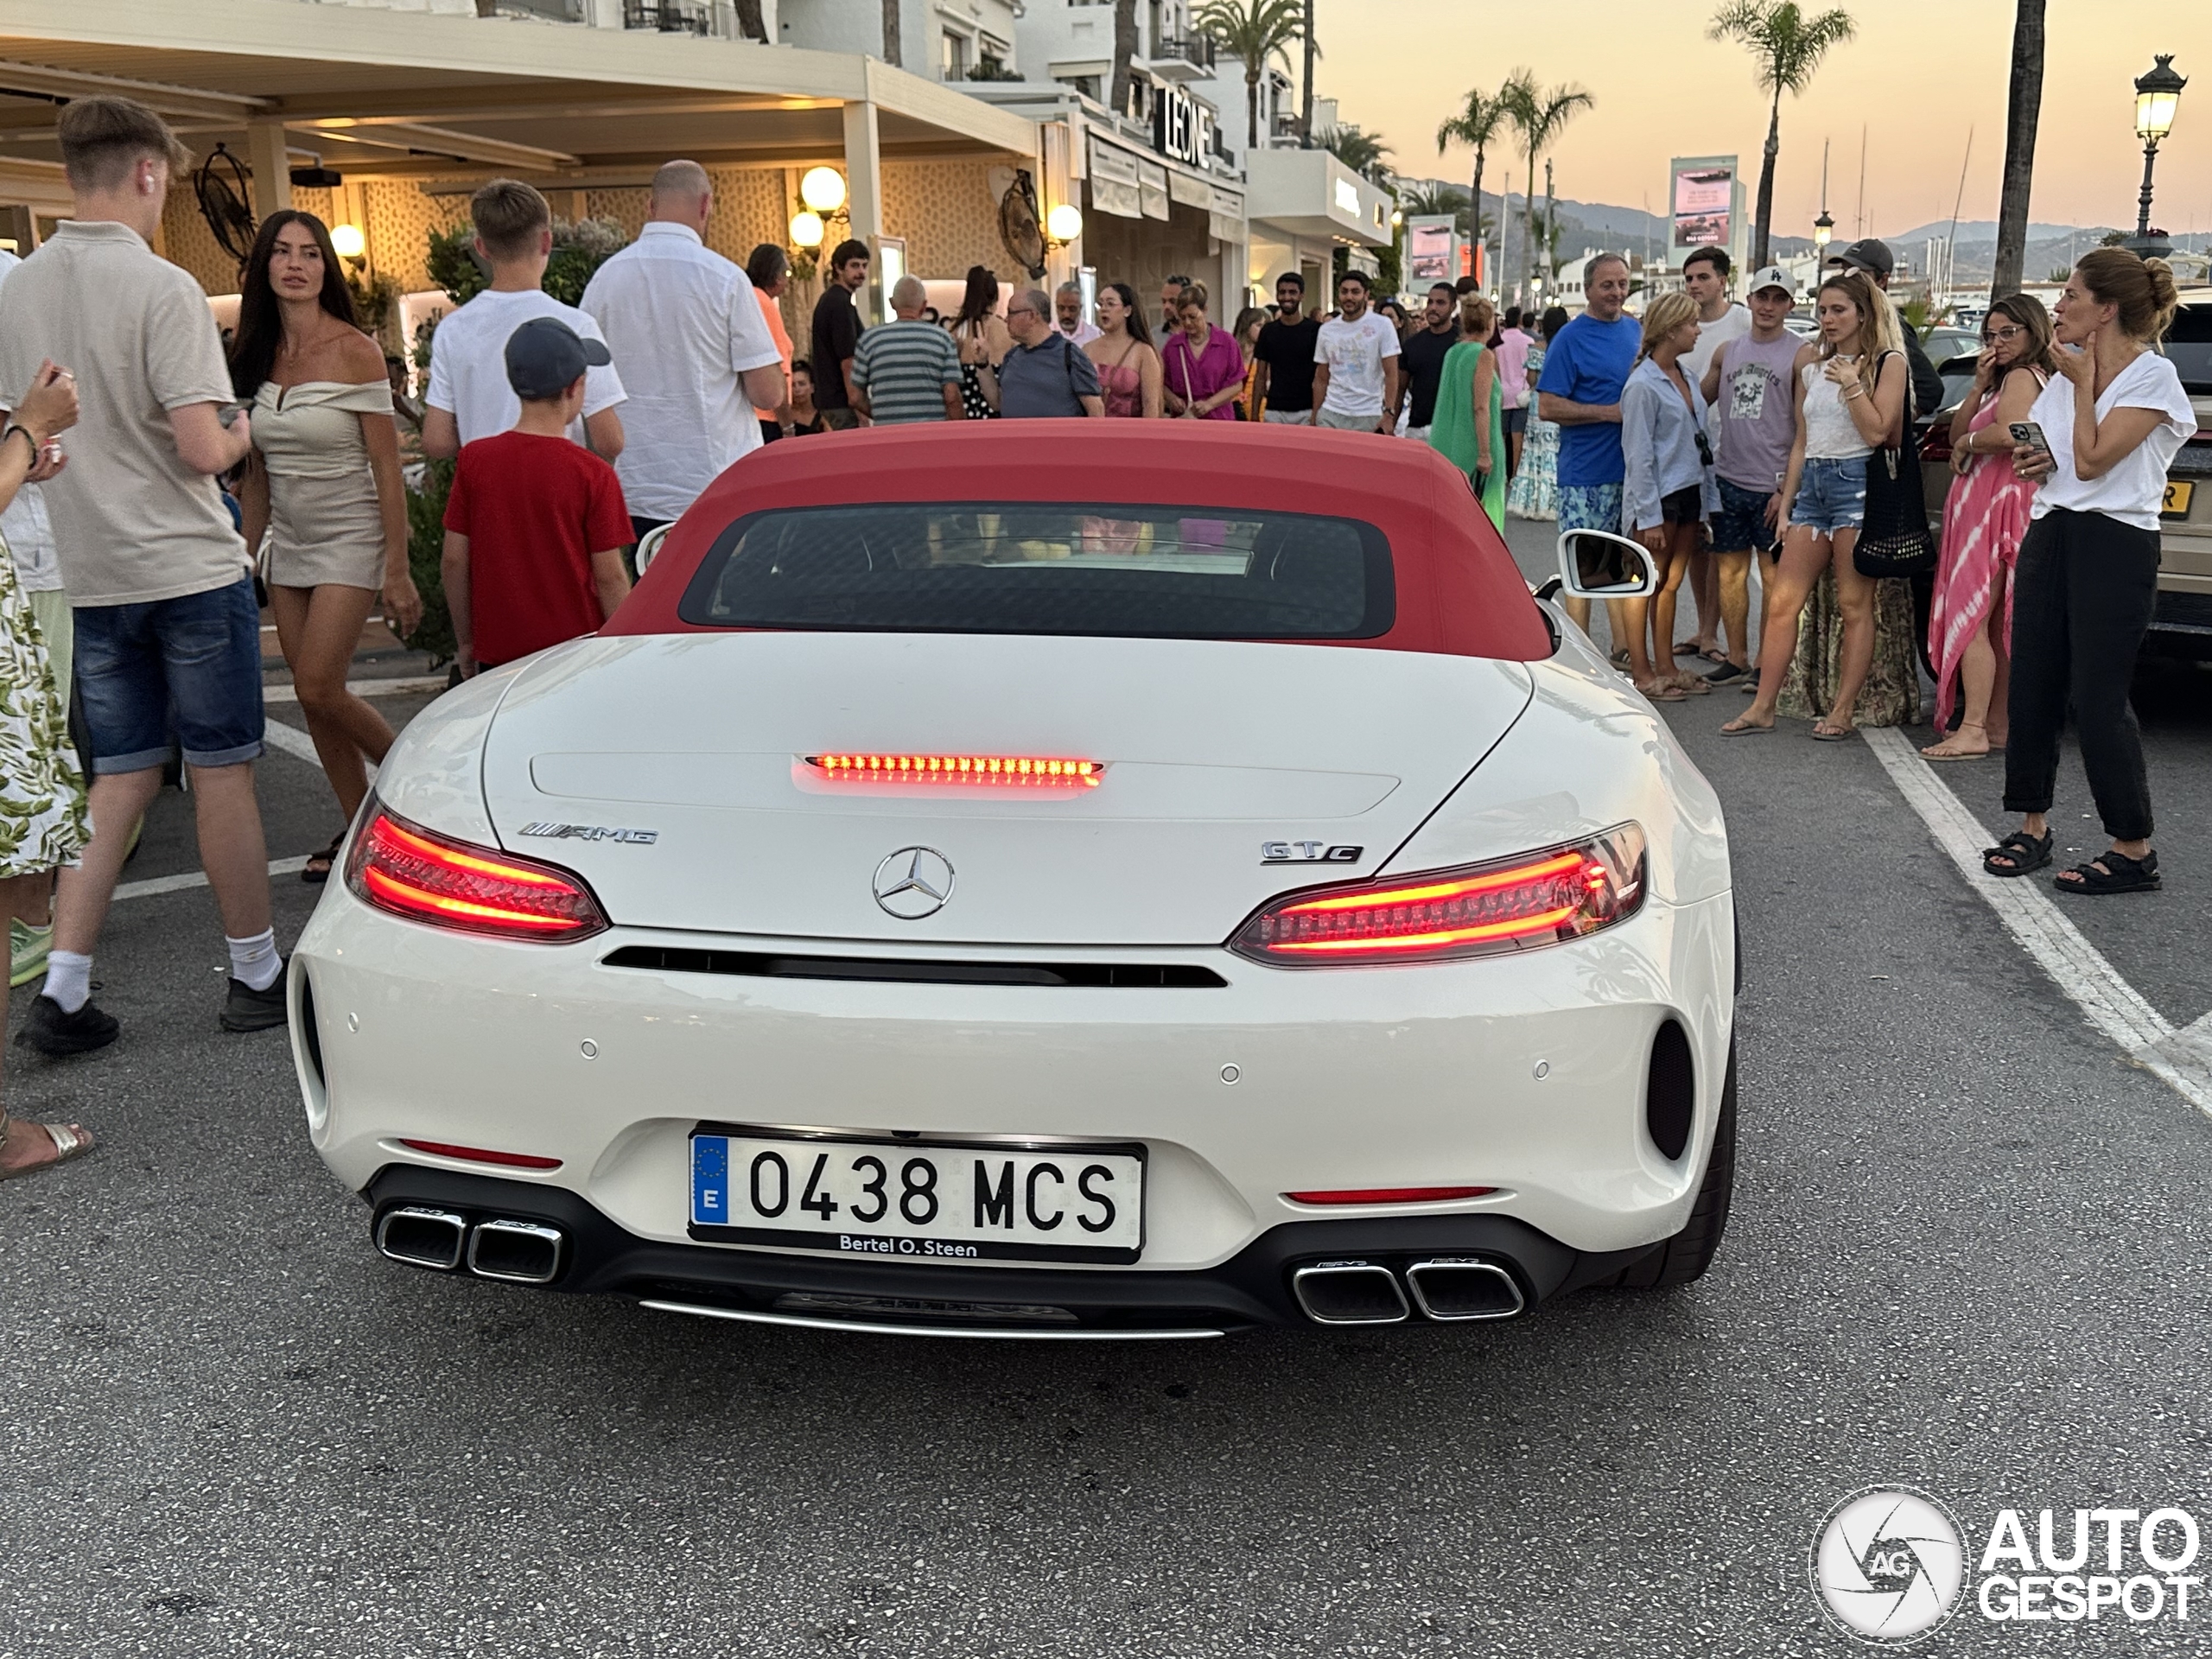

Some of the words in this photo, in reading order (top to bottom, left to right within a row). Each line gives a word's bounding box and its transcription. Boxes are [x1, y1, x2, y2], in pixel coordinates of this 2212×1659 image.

[1164, 86, 1210, 169] LEONE
[1726, 368, 1743, 384] Los
[1745, 363, 1781, 387] Angeles
[703, 1189, 719, 1209] E
[749, 1150, 939, 1225] 0438
[973, 1159, 1116, 1233] MCS
[840, 1235, 894, 1253] Bertel
[899, 1238, 921, 1255] O.
[924, 1240, 978, 1257] Steen
